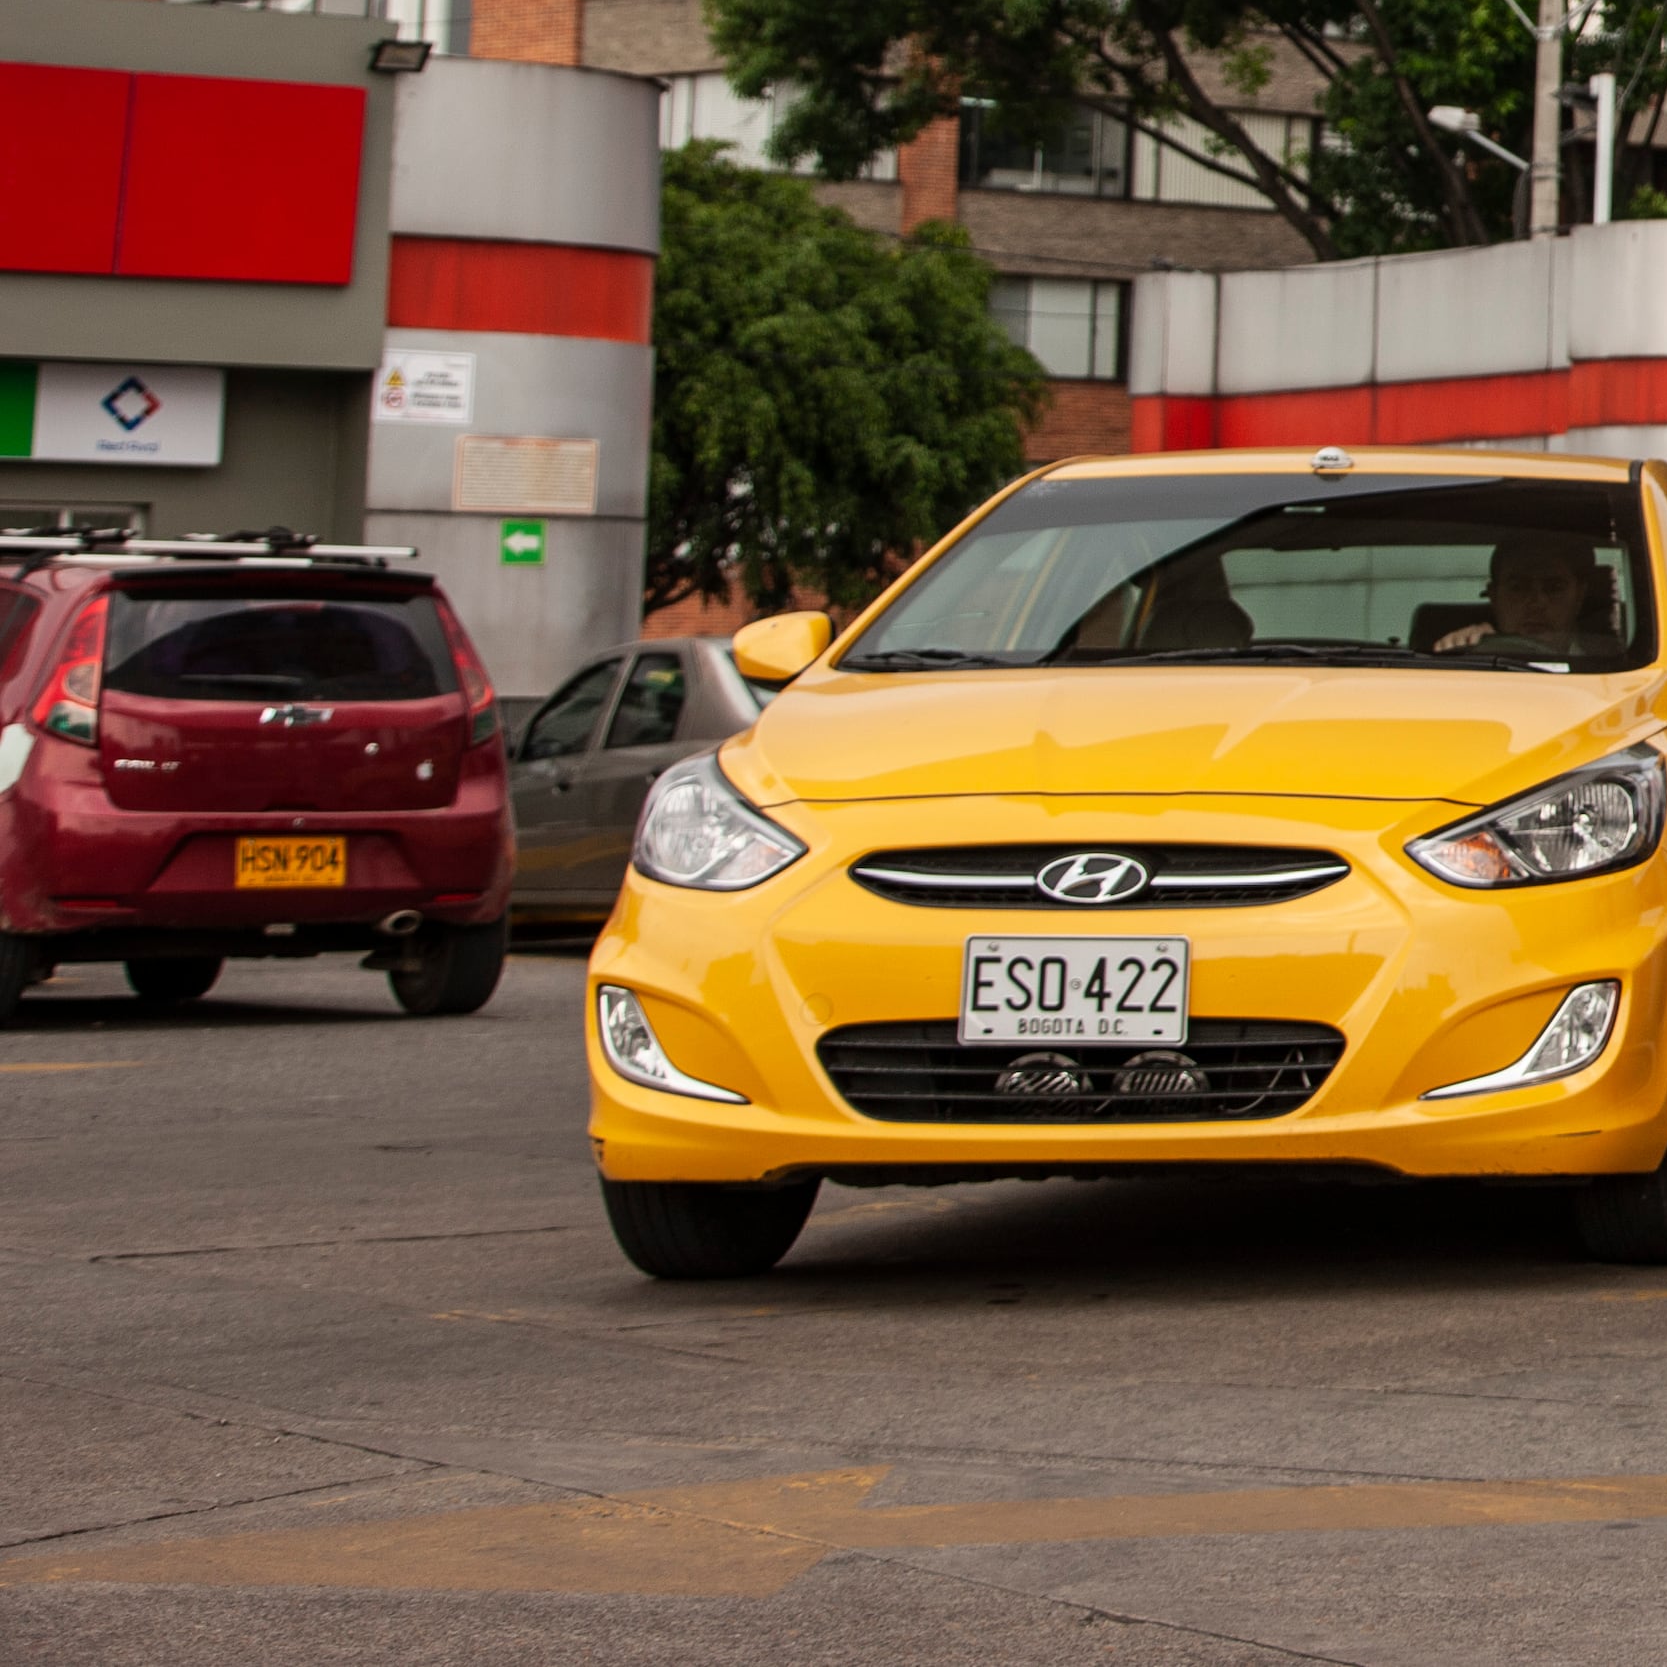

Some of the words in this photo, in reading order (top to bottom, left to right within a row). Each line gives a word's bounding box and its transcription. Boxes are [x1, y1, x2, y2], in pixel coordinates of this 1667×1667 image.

[971, 955, 1068, 1012] ESO
[1083, 956, 1180, 1012] 422
[1017, 1017, 1086, 1035] BOGOTA
[1098, 1018, 1130, 1036] D.C.
